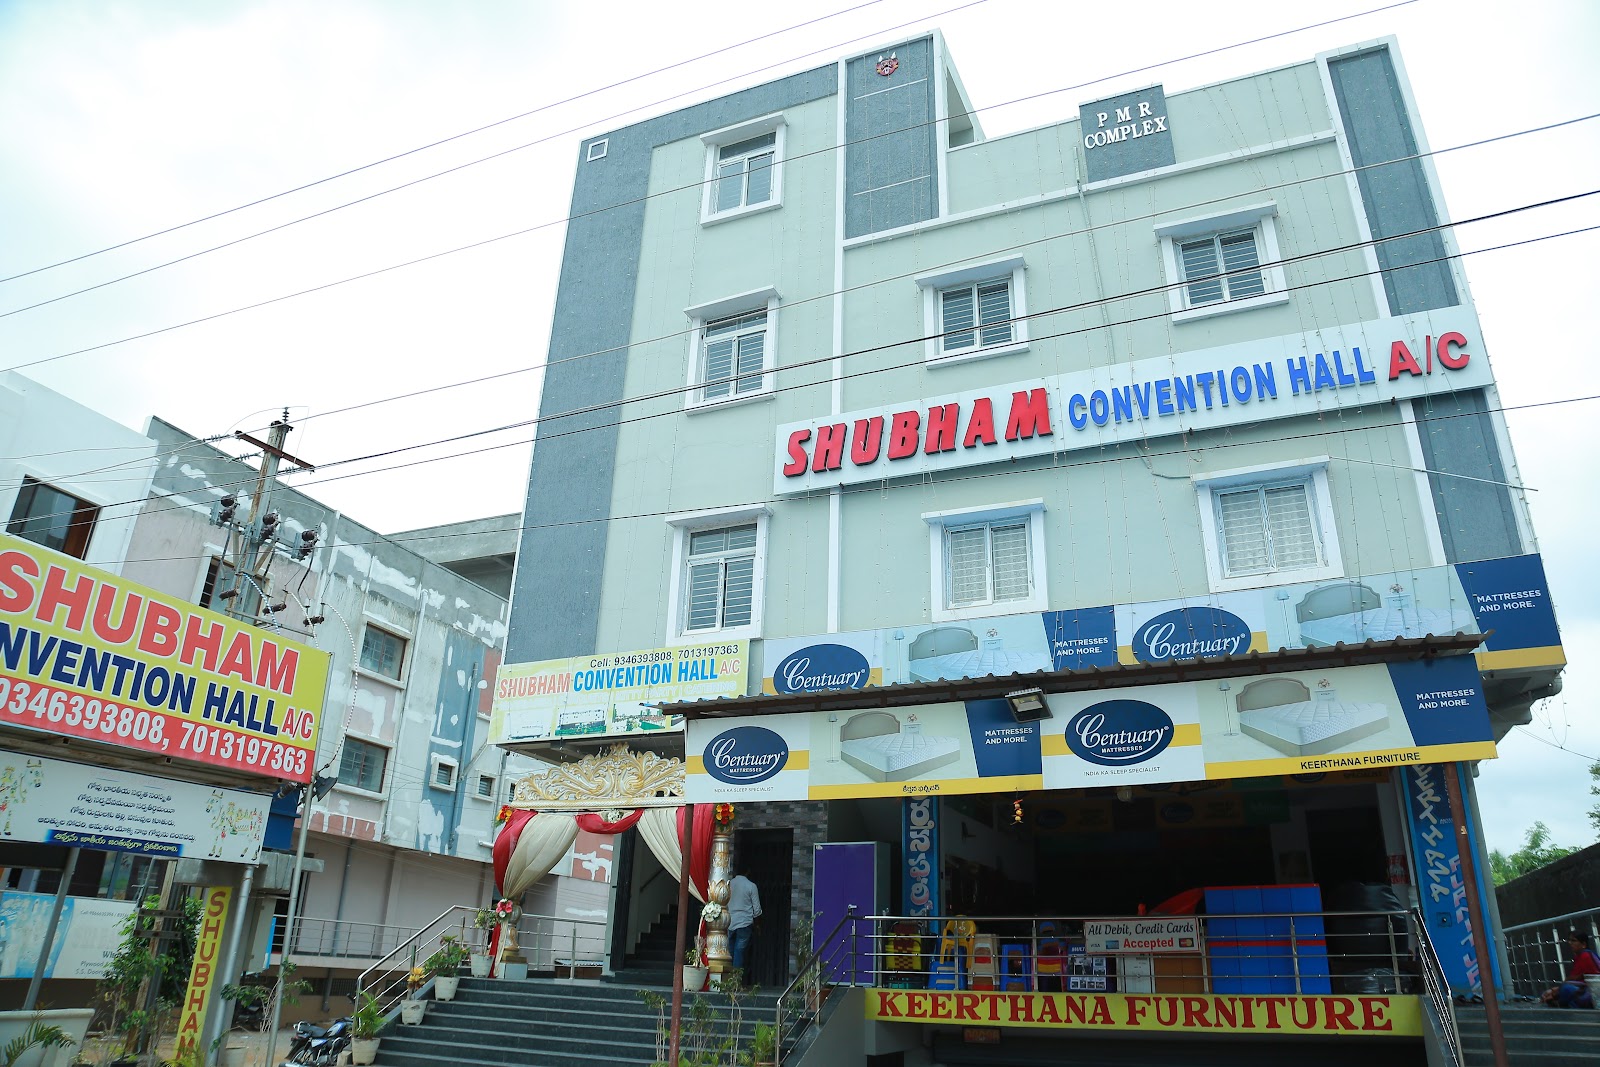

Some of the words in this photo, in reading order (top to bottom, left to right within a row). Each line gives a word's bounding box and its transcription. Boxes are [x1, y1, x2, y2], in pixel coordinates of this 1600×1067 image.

[1096, 112, 1108, 127] P
[1115, 106, 1132, 123] M
[1138, 102, 1152, 118] R
[1084, 116, 1167, 149] COMPLEX
[783, 387, 1053, 478] SHUBHAM
[1068, 362, 1277, 431] CONVENTION
[1287, 347, 1376, 395] HALL
[1388, 331, 1470, 381] A/C
[1476, 589, 1541, 603] MATTRESSES
[1479, 604, 1501, 613] AND
[1503, 600, 1536, 611] MORE.
[0, 551, 300, 696] SHUBHAM
[1056, 637, 1108, 648] MATTRESSES
[590, 658, 611, 669] Cell:
[614, 651, 674, 667] 9346393808,
[678, 644, 739, 660] 7013197363
[1056, 648, 1074, 657] AND
[1076, 646, 1102, 655] MORE.
[0, 622, 197, 714] NVENTION
[203, 682, 279, 736] HALL
[281, 707, 314, 739] A/C
[499, 672, 571, 698] SHUBHAM
[573, 662, 672, 692] CONVENTION
[678, 658, 718, 682] HALL
[720, 659, 740, 675] A/C
[686, 681, 737, 695] CATERING
[1416, 688, 1475, 700] MATTRESSES
[1418, 701, 1438, 710] AND
[1440, 699, 1470, 708] MORE.
[985, 727, 1033, 737] MATTRESSES
[985, 737, 1002, 745] AND
[1003, 735, 1028, 743] MORE.
[180, 722, 307, 776] 7013197363
[1101, 745, 1143, 753] MATTRESSES
[1300, 756, 1361, 771] KEERTHANA
[1363, 752, 1421, 765] FURNITURE
[1411, 764, 1450, 902] EERTHANA
[1088, 924, 1102, 936] All
[1104, 924, 1132, 937] Debit,
[1135, 923, 1163, 935] Credit
[1166, 922, 1194, 934] Cards
[1123, 937, 1174, 950] Accepted
[175, 890, 227, 1060] SHUBHAM
[877, 991, 1115, 1025] KEERTHANA
[1125, 996, 1393, 1031] FURNITURE
